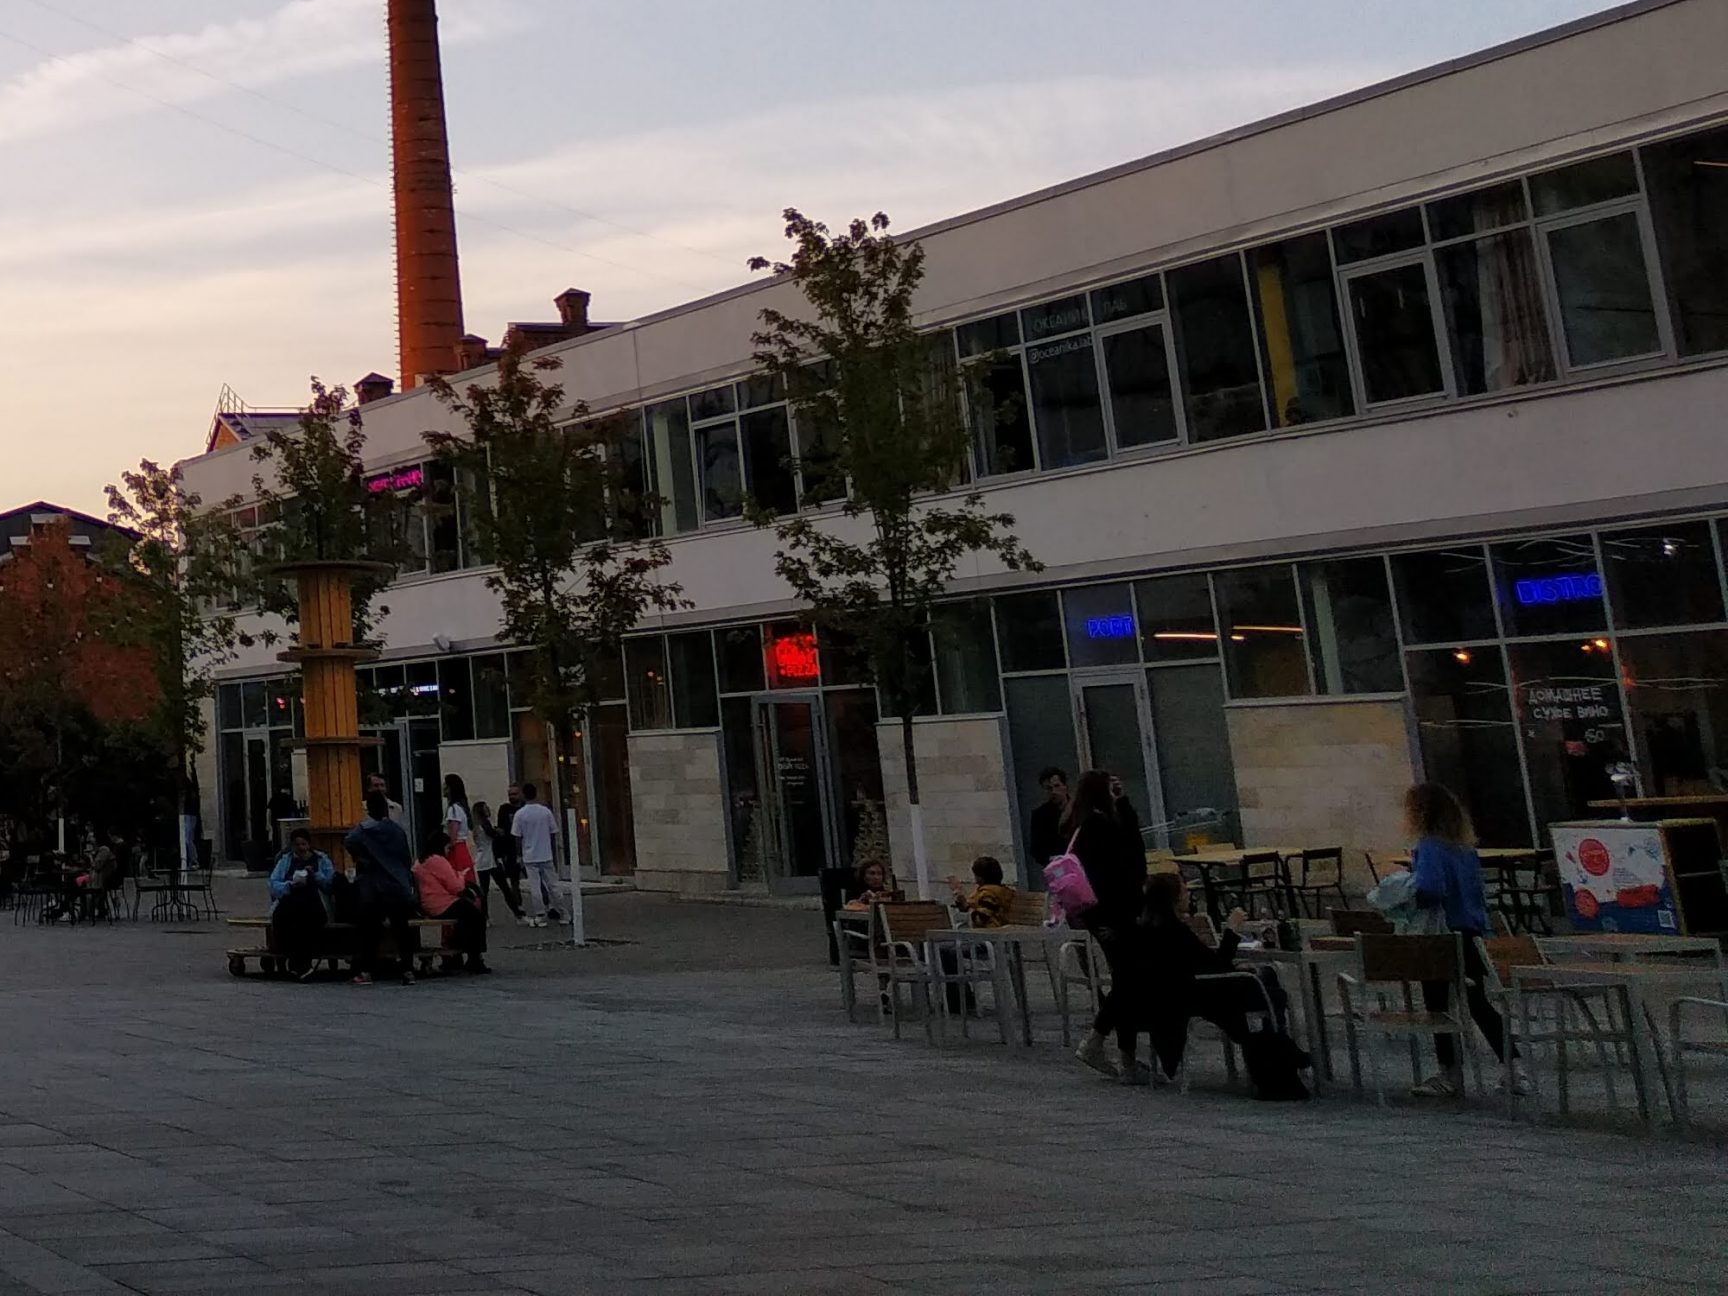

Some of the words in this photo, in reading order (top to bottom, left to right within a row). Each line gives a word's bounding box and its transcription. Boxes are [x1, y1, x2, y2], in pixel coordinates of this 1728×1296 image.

[1516, 574, 1603, 604] BISTRO
[1087, 616, 1133, 638] PORT
[1528, 688, 1603, 705] ДОМАШНЕЕ
[1533, 707, 1573, 720] СУХОЕ
[1577, 704, 1609, 719] ВИНО
